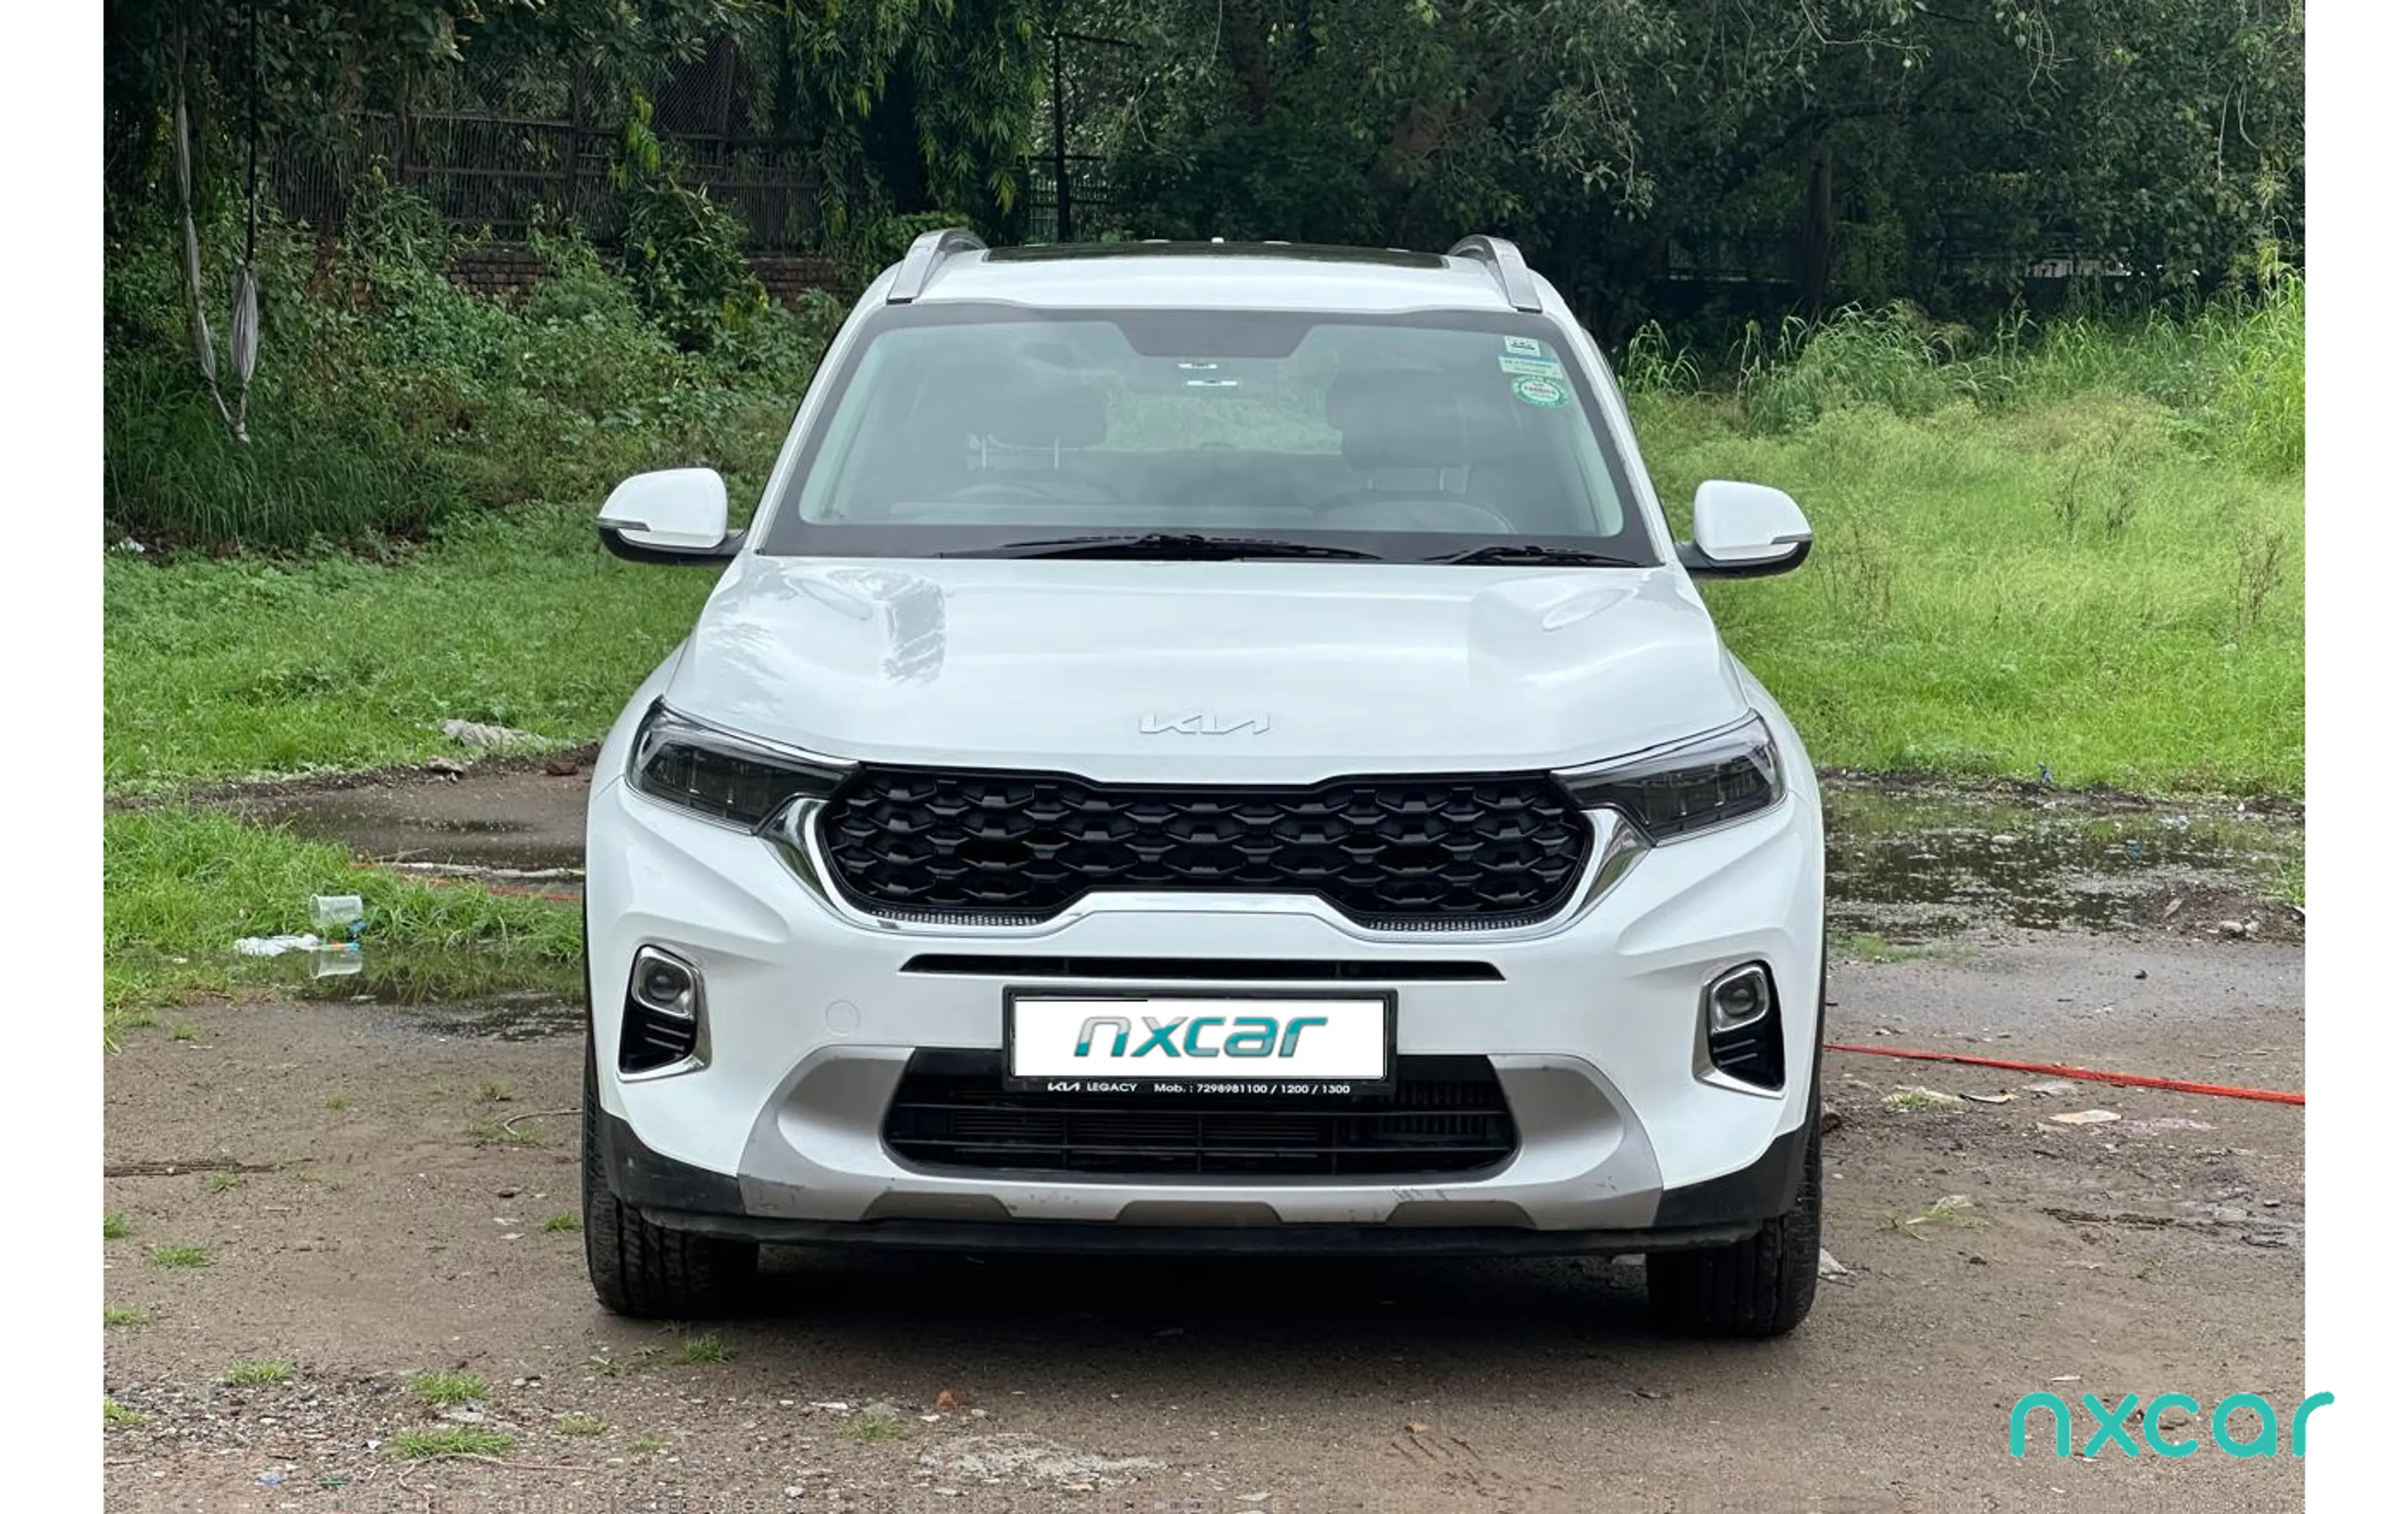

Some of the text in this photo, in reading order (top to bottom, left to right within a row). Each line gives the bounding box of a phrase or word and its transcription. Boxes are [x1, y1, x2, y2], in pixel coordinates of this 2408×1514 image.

[1087, 1082, 1138, 1092] LEGACY
[1154, 1083, 1186, 1093] Mob.
[1196, 1083, 1268, 1094] 7298981100
[1281, 1084, 1309, 1094] 1200
[1323, 1084, 1351, 1094] 1300
